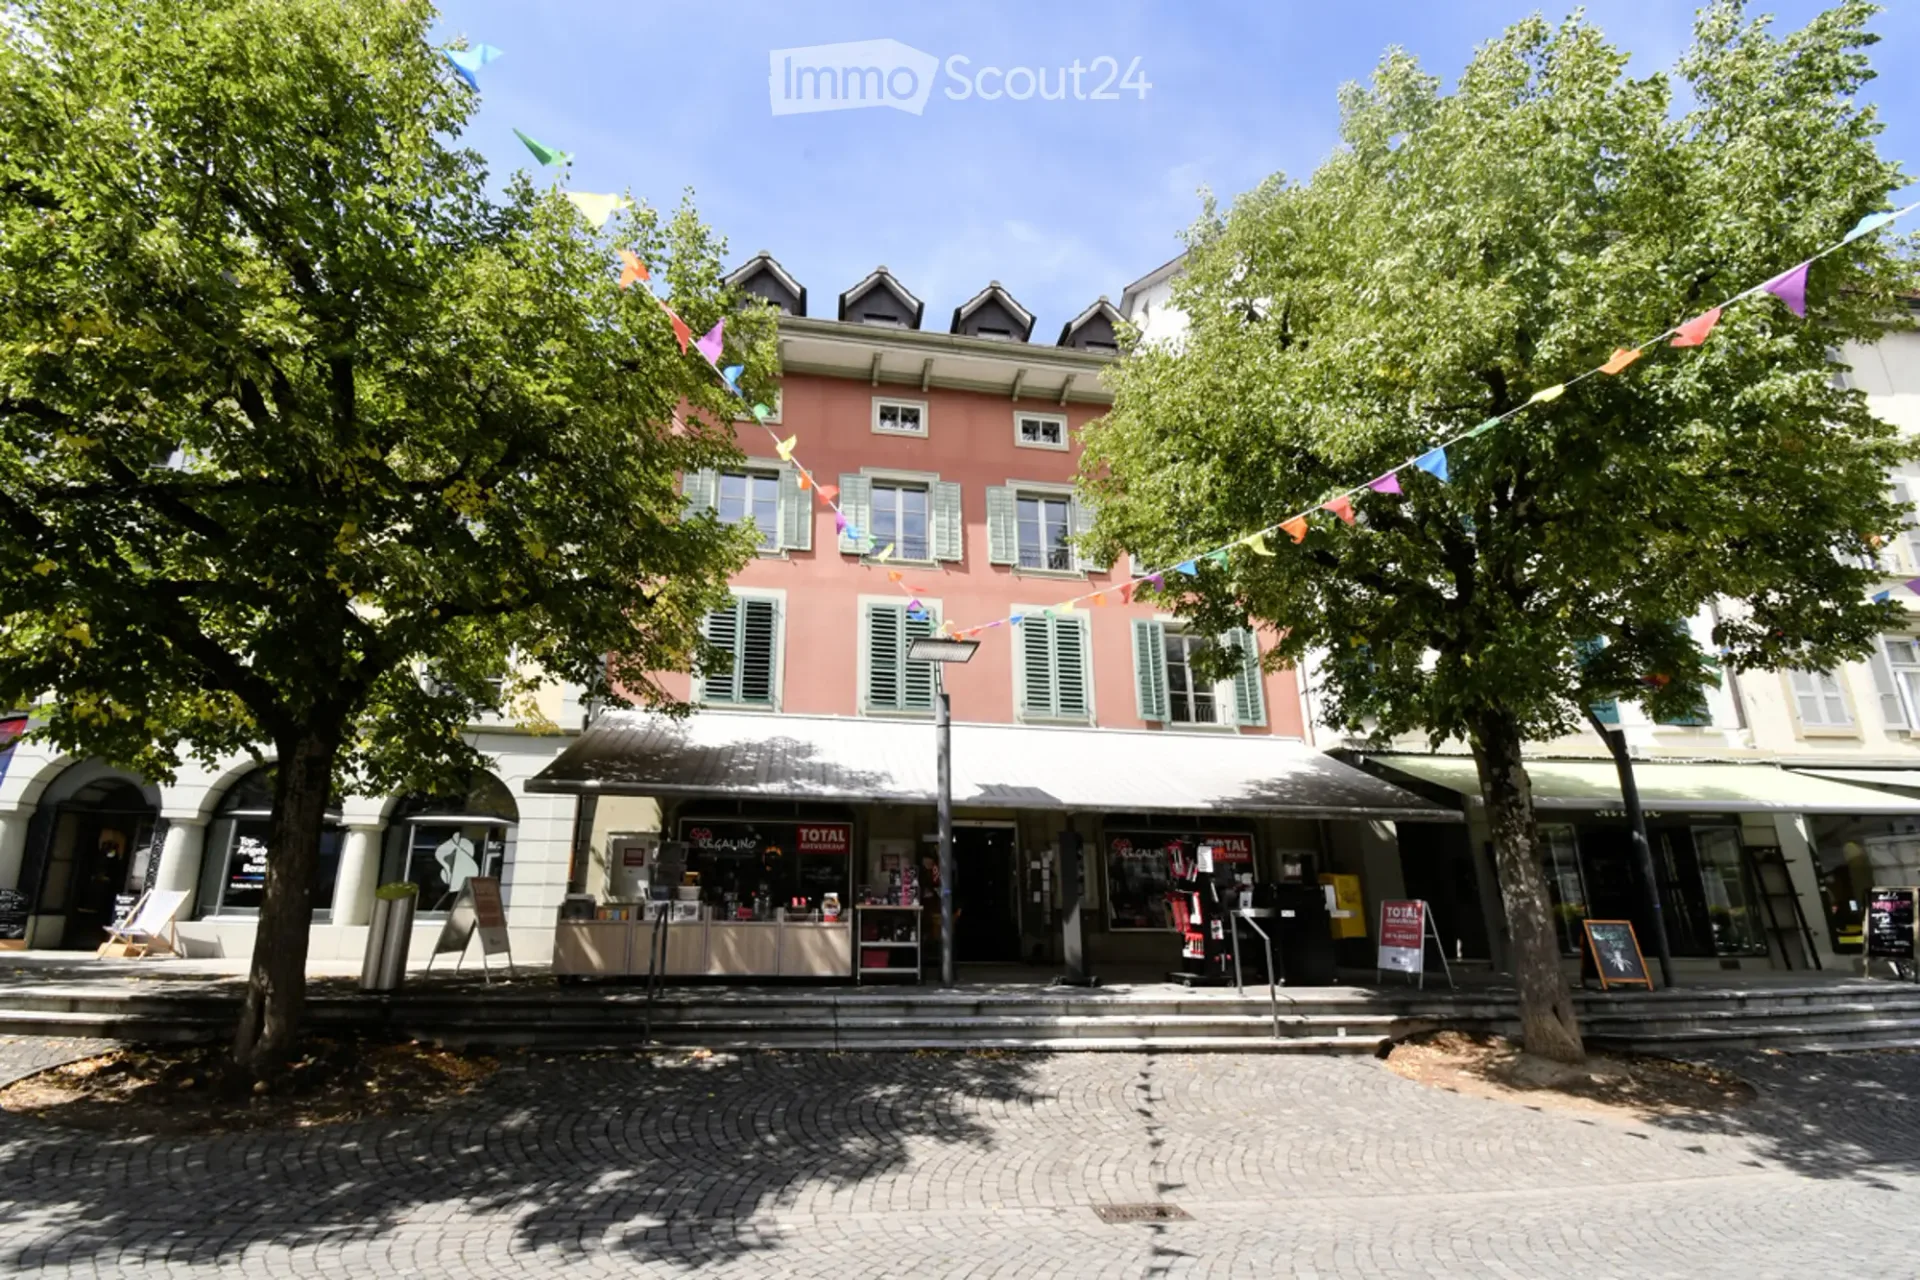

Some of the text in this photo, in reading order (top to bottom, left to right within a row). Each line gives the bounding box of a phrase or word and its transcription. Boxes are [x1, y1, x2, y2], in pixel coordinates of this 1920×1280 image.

[799, 828, 846, 842] TOTAL
[698, 837, 757, 851] REGALINO
[1387, 906, 1418, 918] TOTAL
